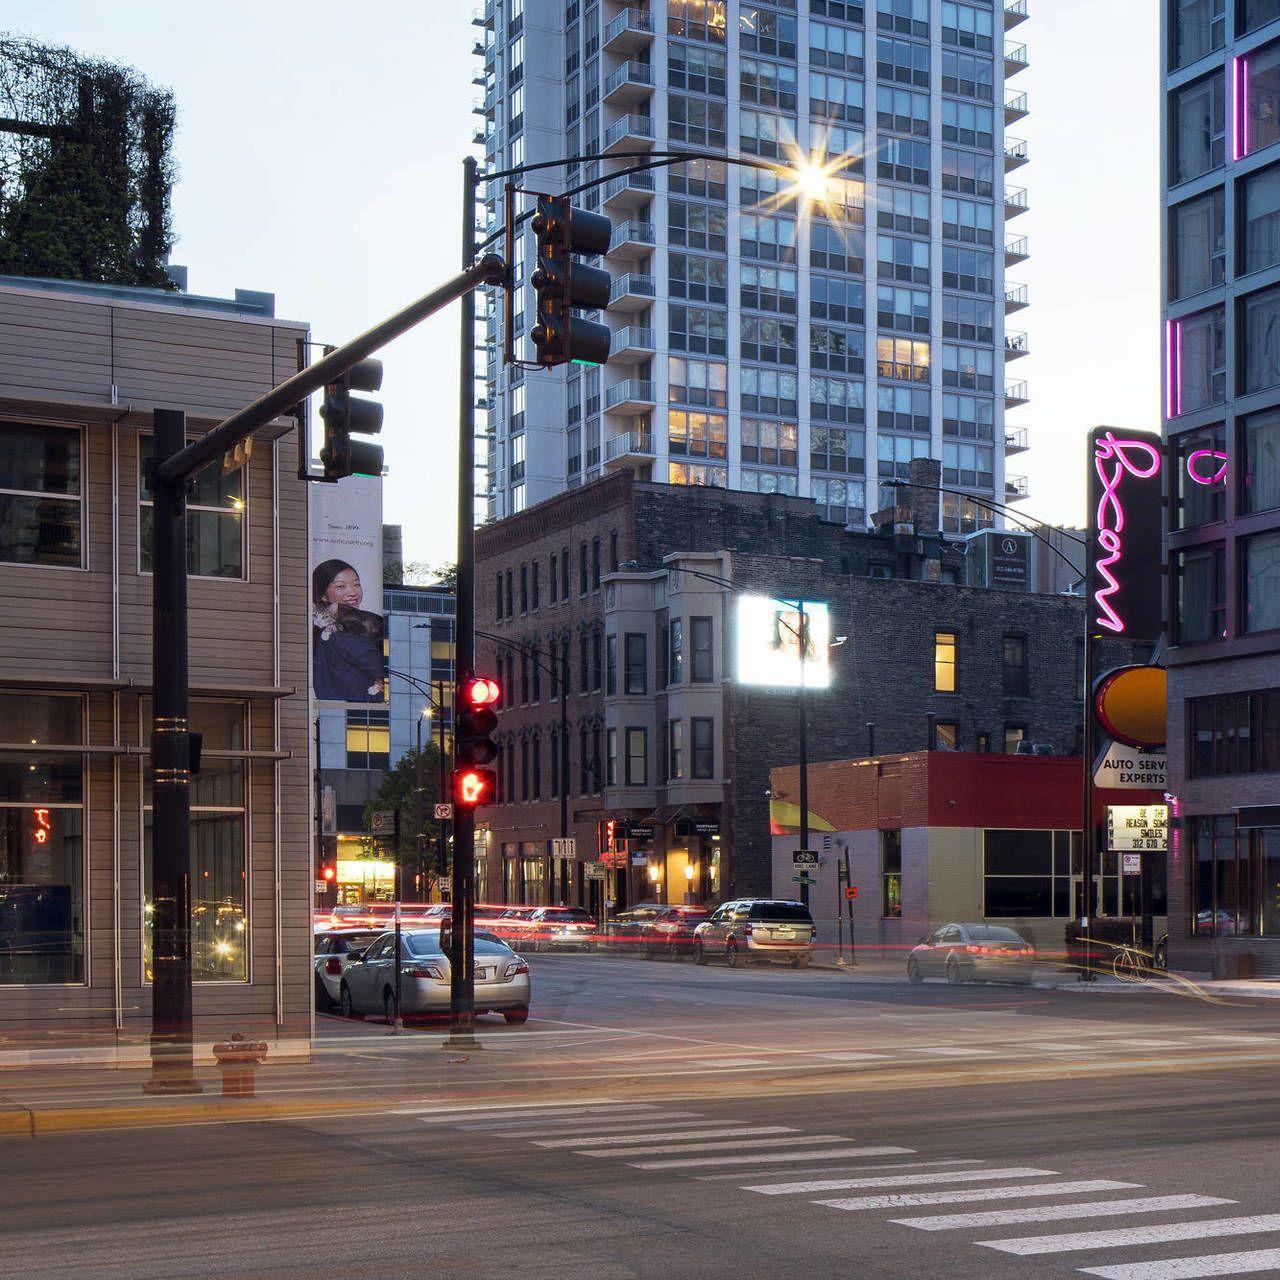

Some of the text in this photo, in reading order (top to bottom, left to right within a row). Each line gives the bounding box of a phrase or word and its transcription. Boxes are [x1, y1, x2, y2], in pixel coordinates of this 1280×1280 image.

[1095, 431, 1161, 632] moxy
[1103, 759, 1168, 771] AUTO SERV
[1119, 772, 1165, 783] EXPERTS
[1126, 818, 1148, 828] REASON
